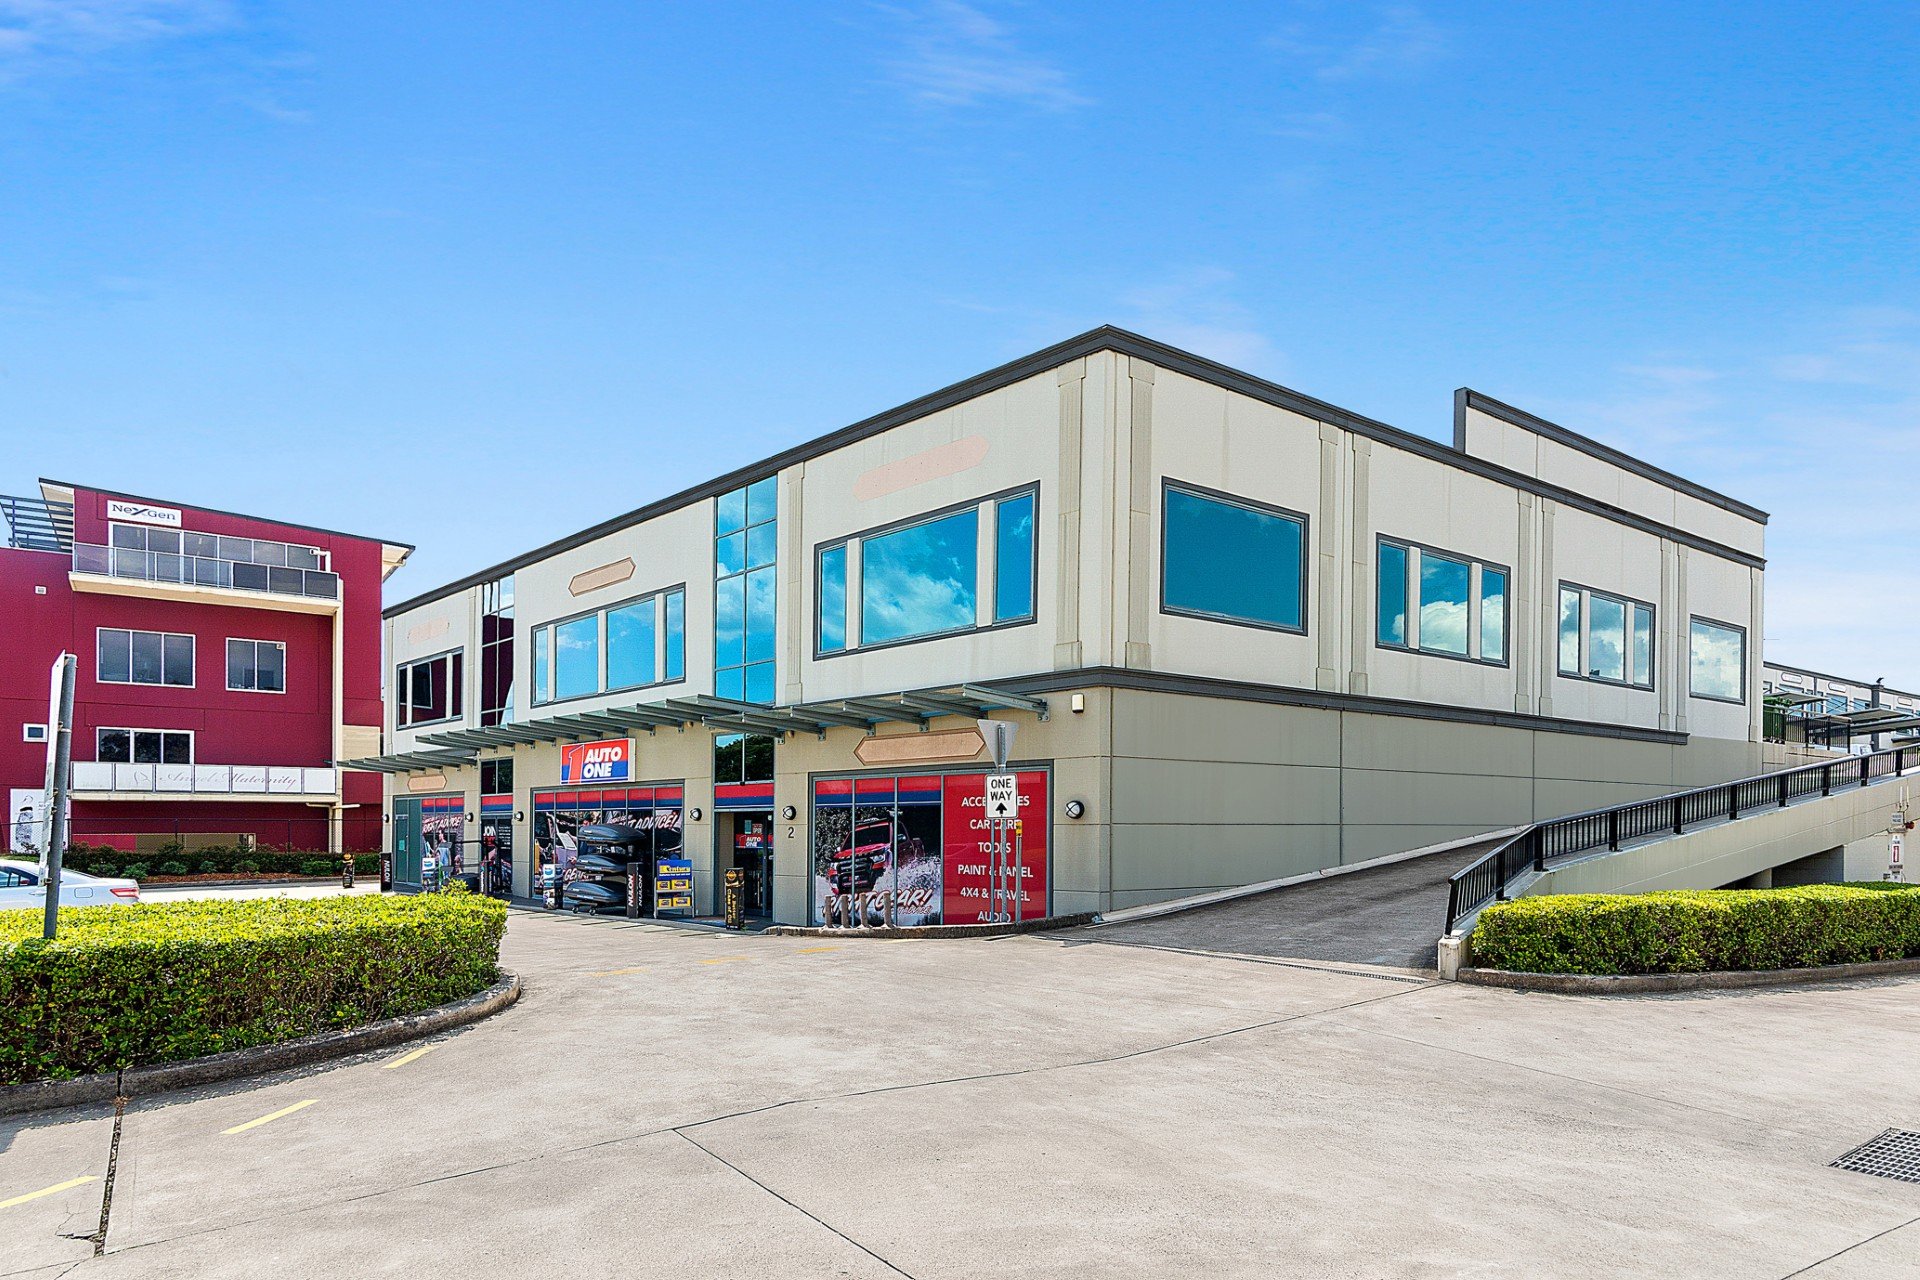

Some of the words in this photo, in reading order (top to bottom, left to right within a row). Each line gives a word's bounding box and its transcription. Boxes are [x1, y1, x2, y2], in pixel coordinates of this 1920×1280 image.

[584, 746, 622, 763] AUTO
[583, 762, 613, 778] ONE
[991, 779, 1011, 788] ONE
[961, 795, 1030, 807] ACCEES
[990, 791, 1012, 801] WAY
[635, 813, 678, 829] ADVICE!
[969, 819, 991, 829] CAR
[788, 827, 794, 838] 2
[957, 865, 987, 875] PAINT
[960, 887, 979, 898] 4X4
[981, 888, 989, 899] &
